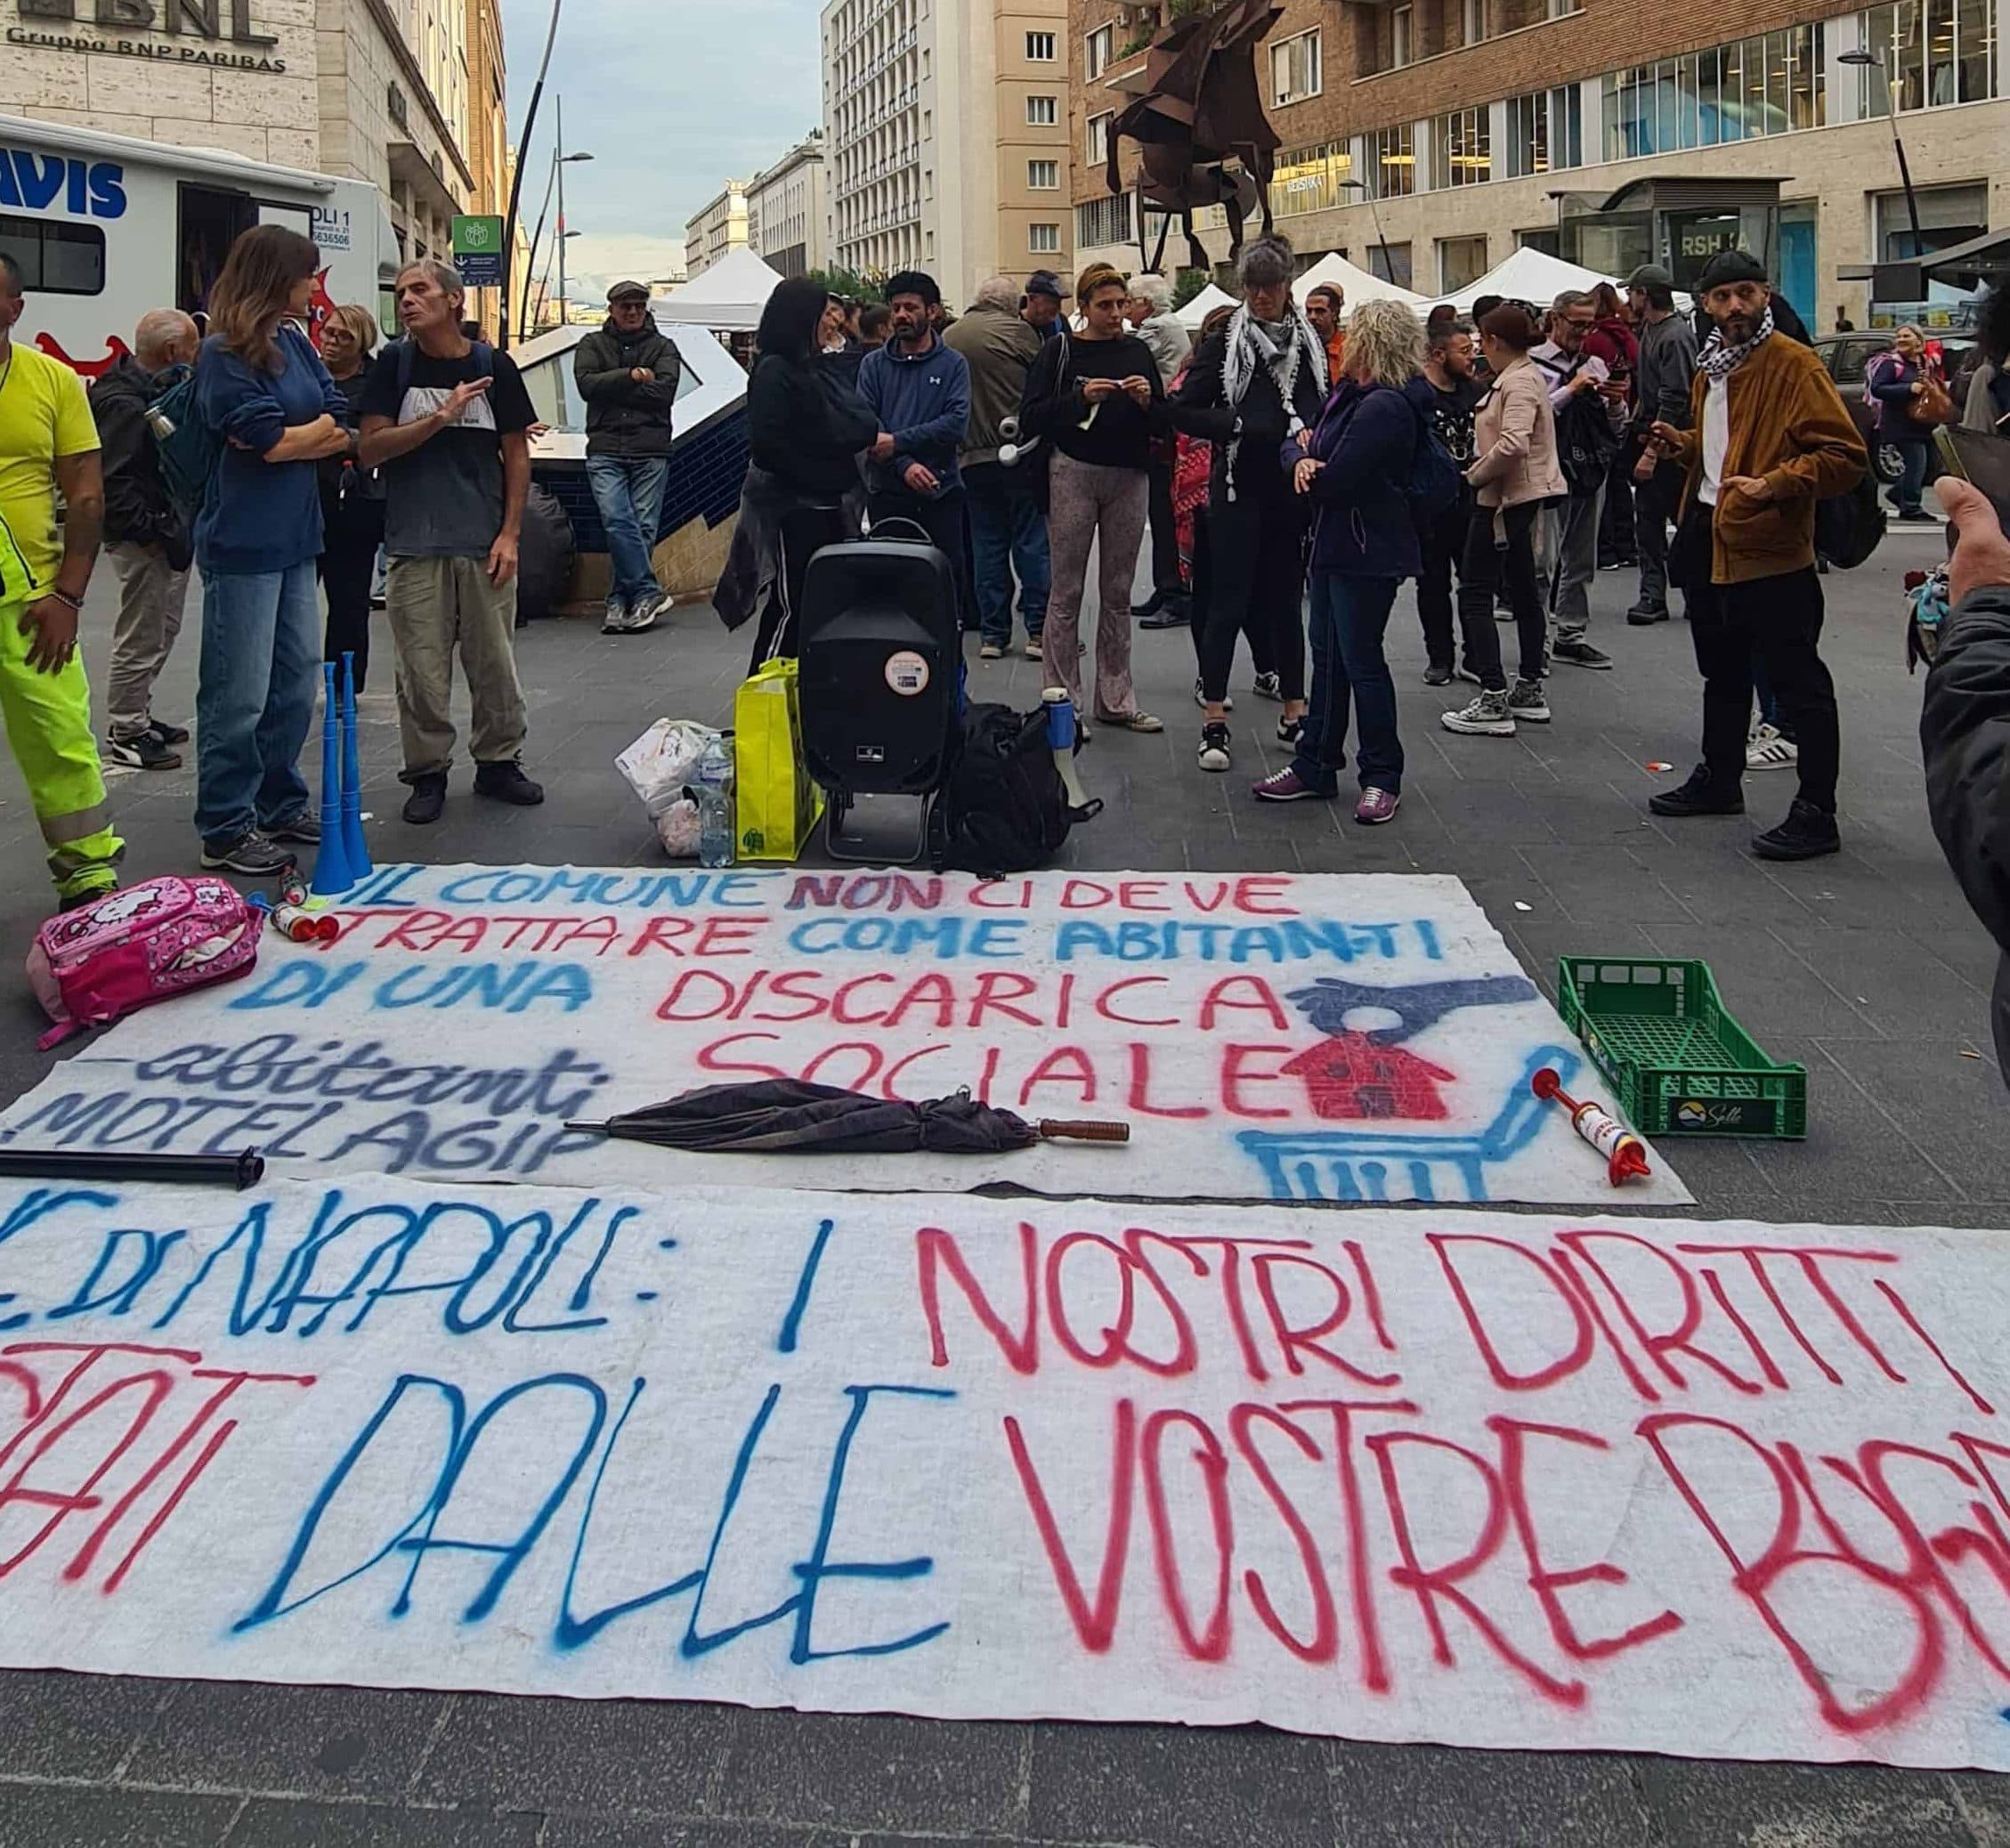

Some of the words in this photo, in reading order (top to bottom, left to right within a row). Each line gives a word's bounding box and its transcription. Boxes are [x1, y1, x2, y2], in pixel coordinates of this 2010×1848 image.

[6, 27, 106, 52] Gruppo
[118, 40, 172, 59] BNP
[180, 47, 287, 73] PARIBAS
[343, 211, 349, 227] 1
[338, 863, 427, 907] IL
[443, 870, 784, 908] COMUNE
[784, 873, 942, 911] NON
[969, 876, 1033, 910] CI
[1059, 875, 1300, 916] DEVE
[326, 908, 770, 958] TRATTARE
[789, 916, 1027, 963] COME
[1054, 918, 1442, 962] ABITANTI
[229, 961, 363, 1013] DI
[374, 960, 592, 1014] UNA
[656, 970, 1291, 1032] DISCARICA
[135, 1034, 611, 1120] abitanti
[2, 1091, 342, 1158] MOTEL
[340, 1109, 604, 1173] AGIP
[779, 1219, 835, 1352] I
[916, 1223, 1403, 1388] NOSTRI
[1425, 1230, 1996, 1414] DIRITTI
[231, 1371, 959, 1666] DALLE
[1004, 1398, 1685, 1711] VOSTRE
